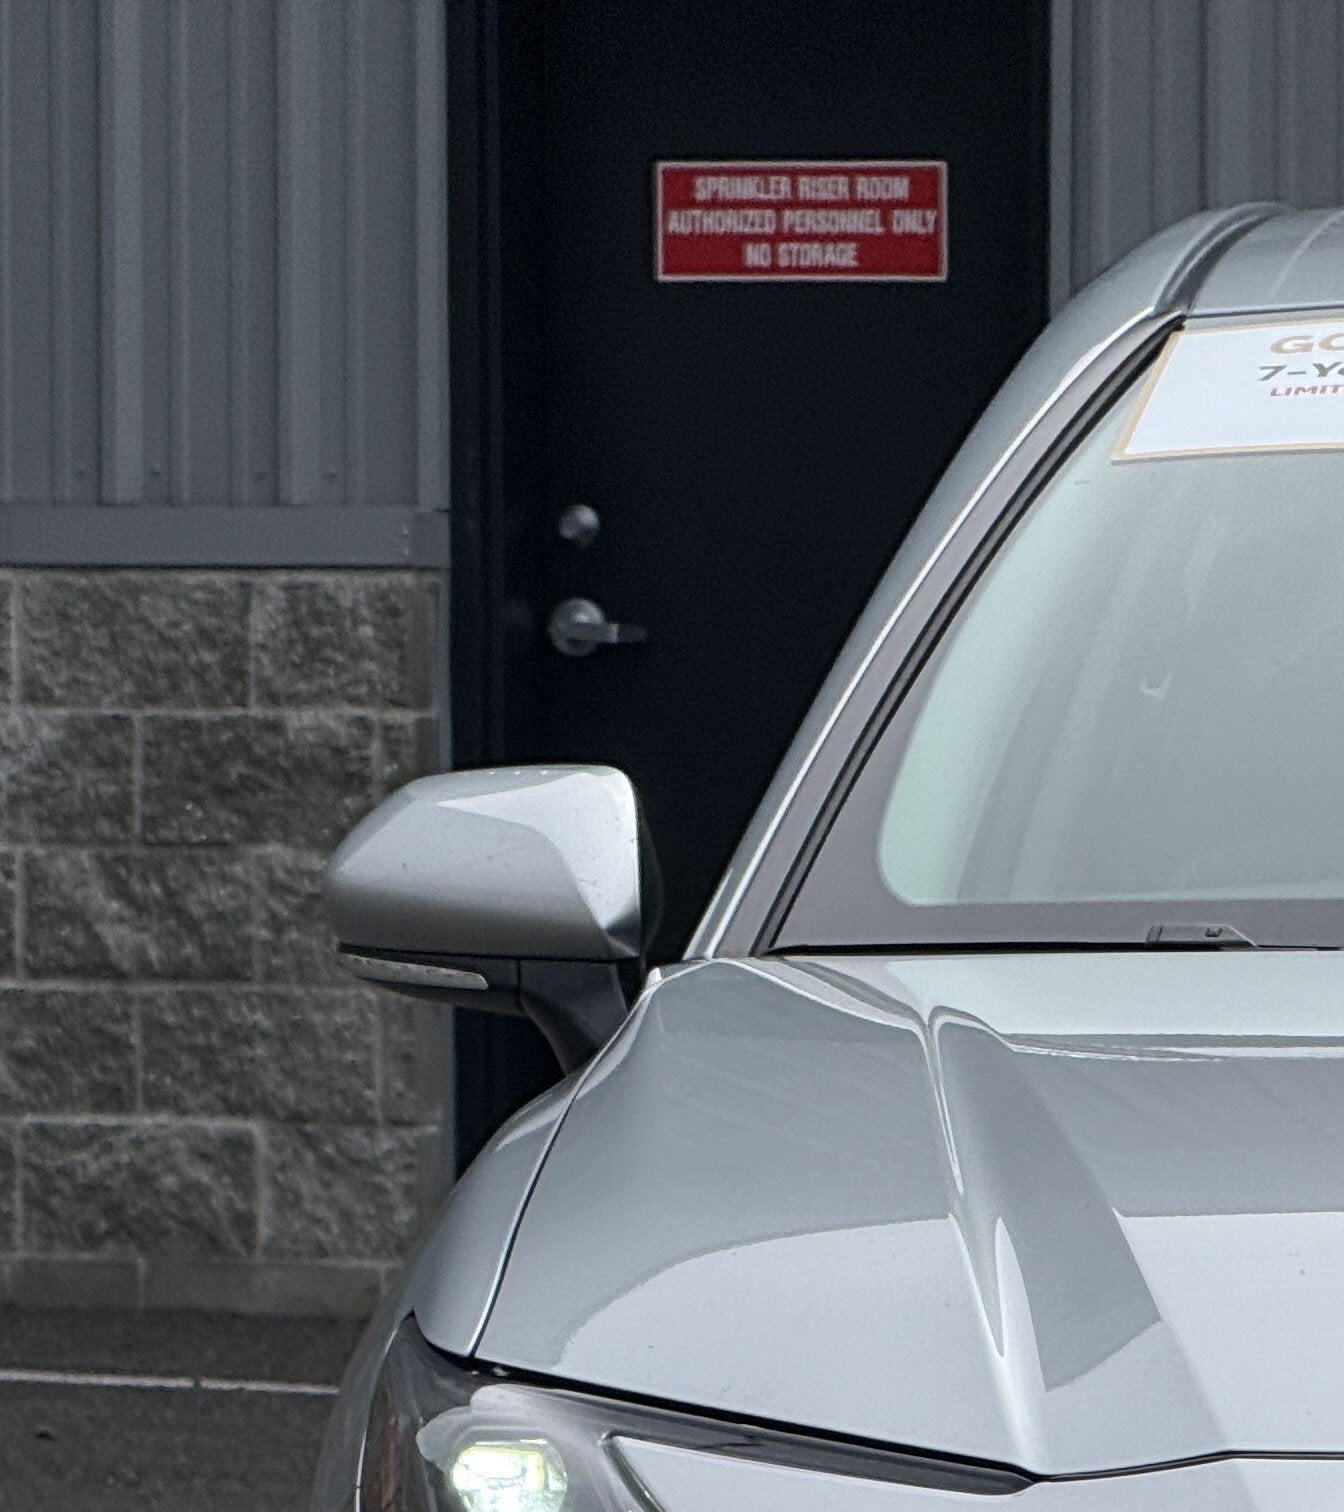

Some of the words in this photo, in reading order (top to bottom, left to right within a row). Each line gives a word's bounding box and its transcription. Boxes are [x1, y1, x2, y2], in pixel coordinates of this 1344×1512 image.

[694, 175, 792, 201] SPRINKLER
[797, 175, 850, 200] RISER
[856, 175, 910, 200] ROOM
[667, 208, 777, 235] AUTHORIZED
[782, 209, 885, 235] PERSONNEL
[891, 209, 938, 235] ONLY
[744, 242, 772, 269] NO
[777, 242, 859, 268] STORAGE
